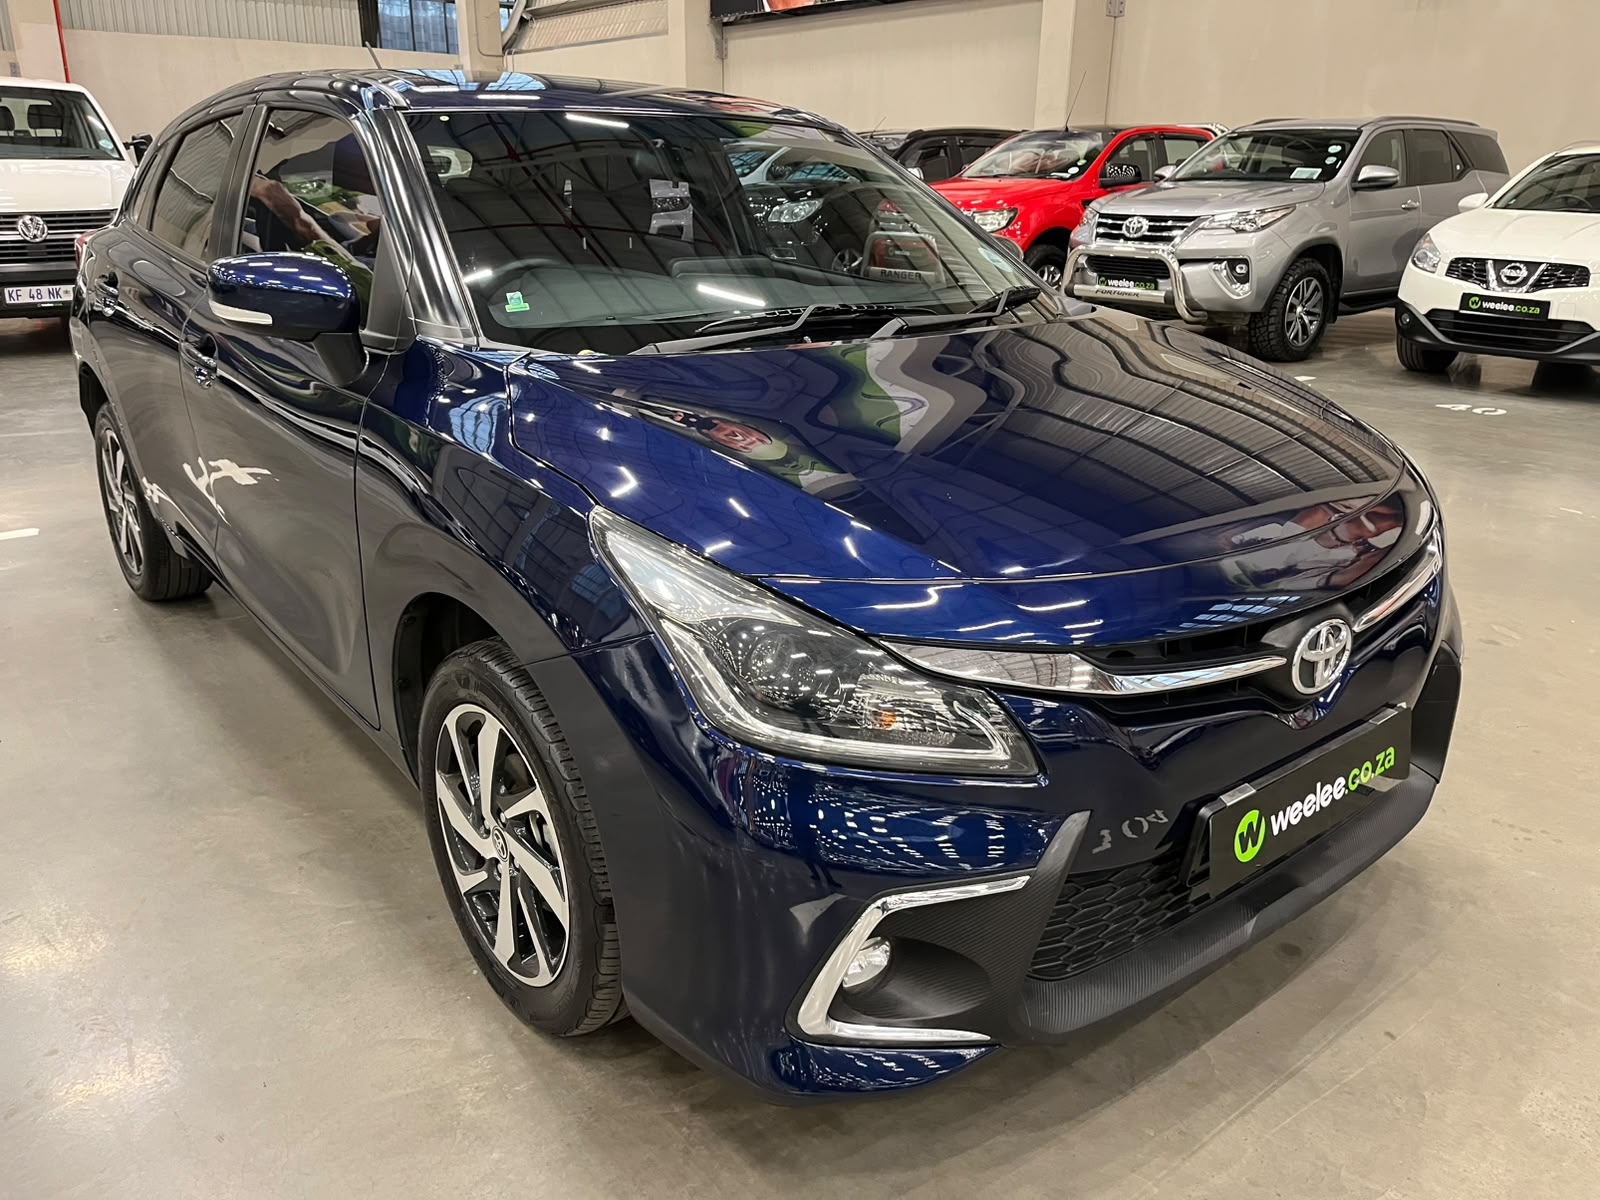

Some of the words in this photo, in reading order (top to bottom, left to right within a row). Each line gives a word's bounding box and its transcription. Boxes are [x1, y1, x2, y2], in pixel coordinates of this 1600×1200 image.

[880, 269, 922, 280] RANGER
[7, 288, 22, 301] KF
[28, 288, 43, 300] 48
[47, 287, 63, 299] NK
[1095, 289, 1140, 298] FORTUNER
[1482, 301, 1541, 314] weelee.co.za
[1270, 746, 1396, 836] weelee.co.za
